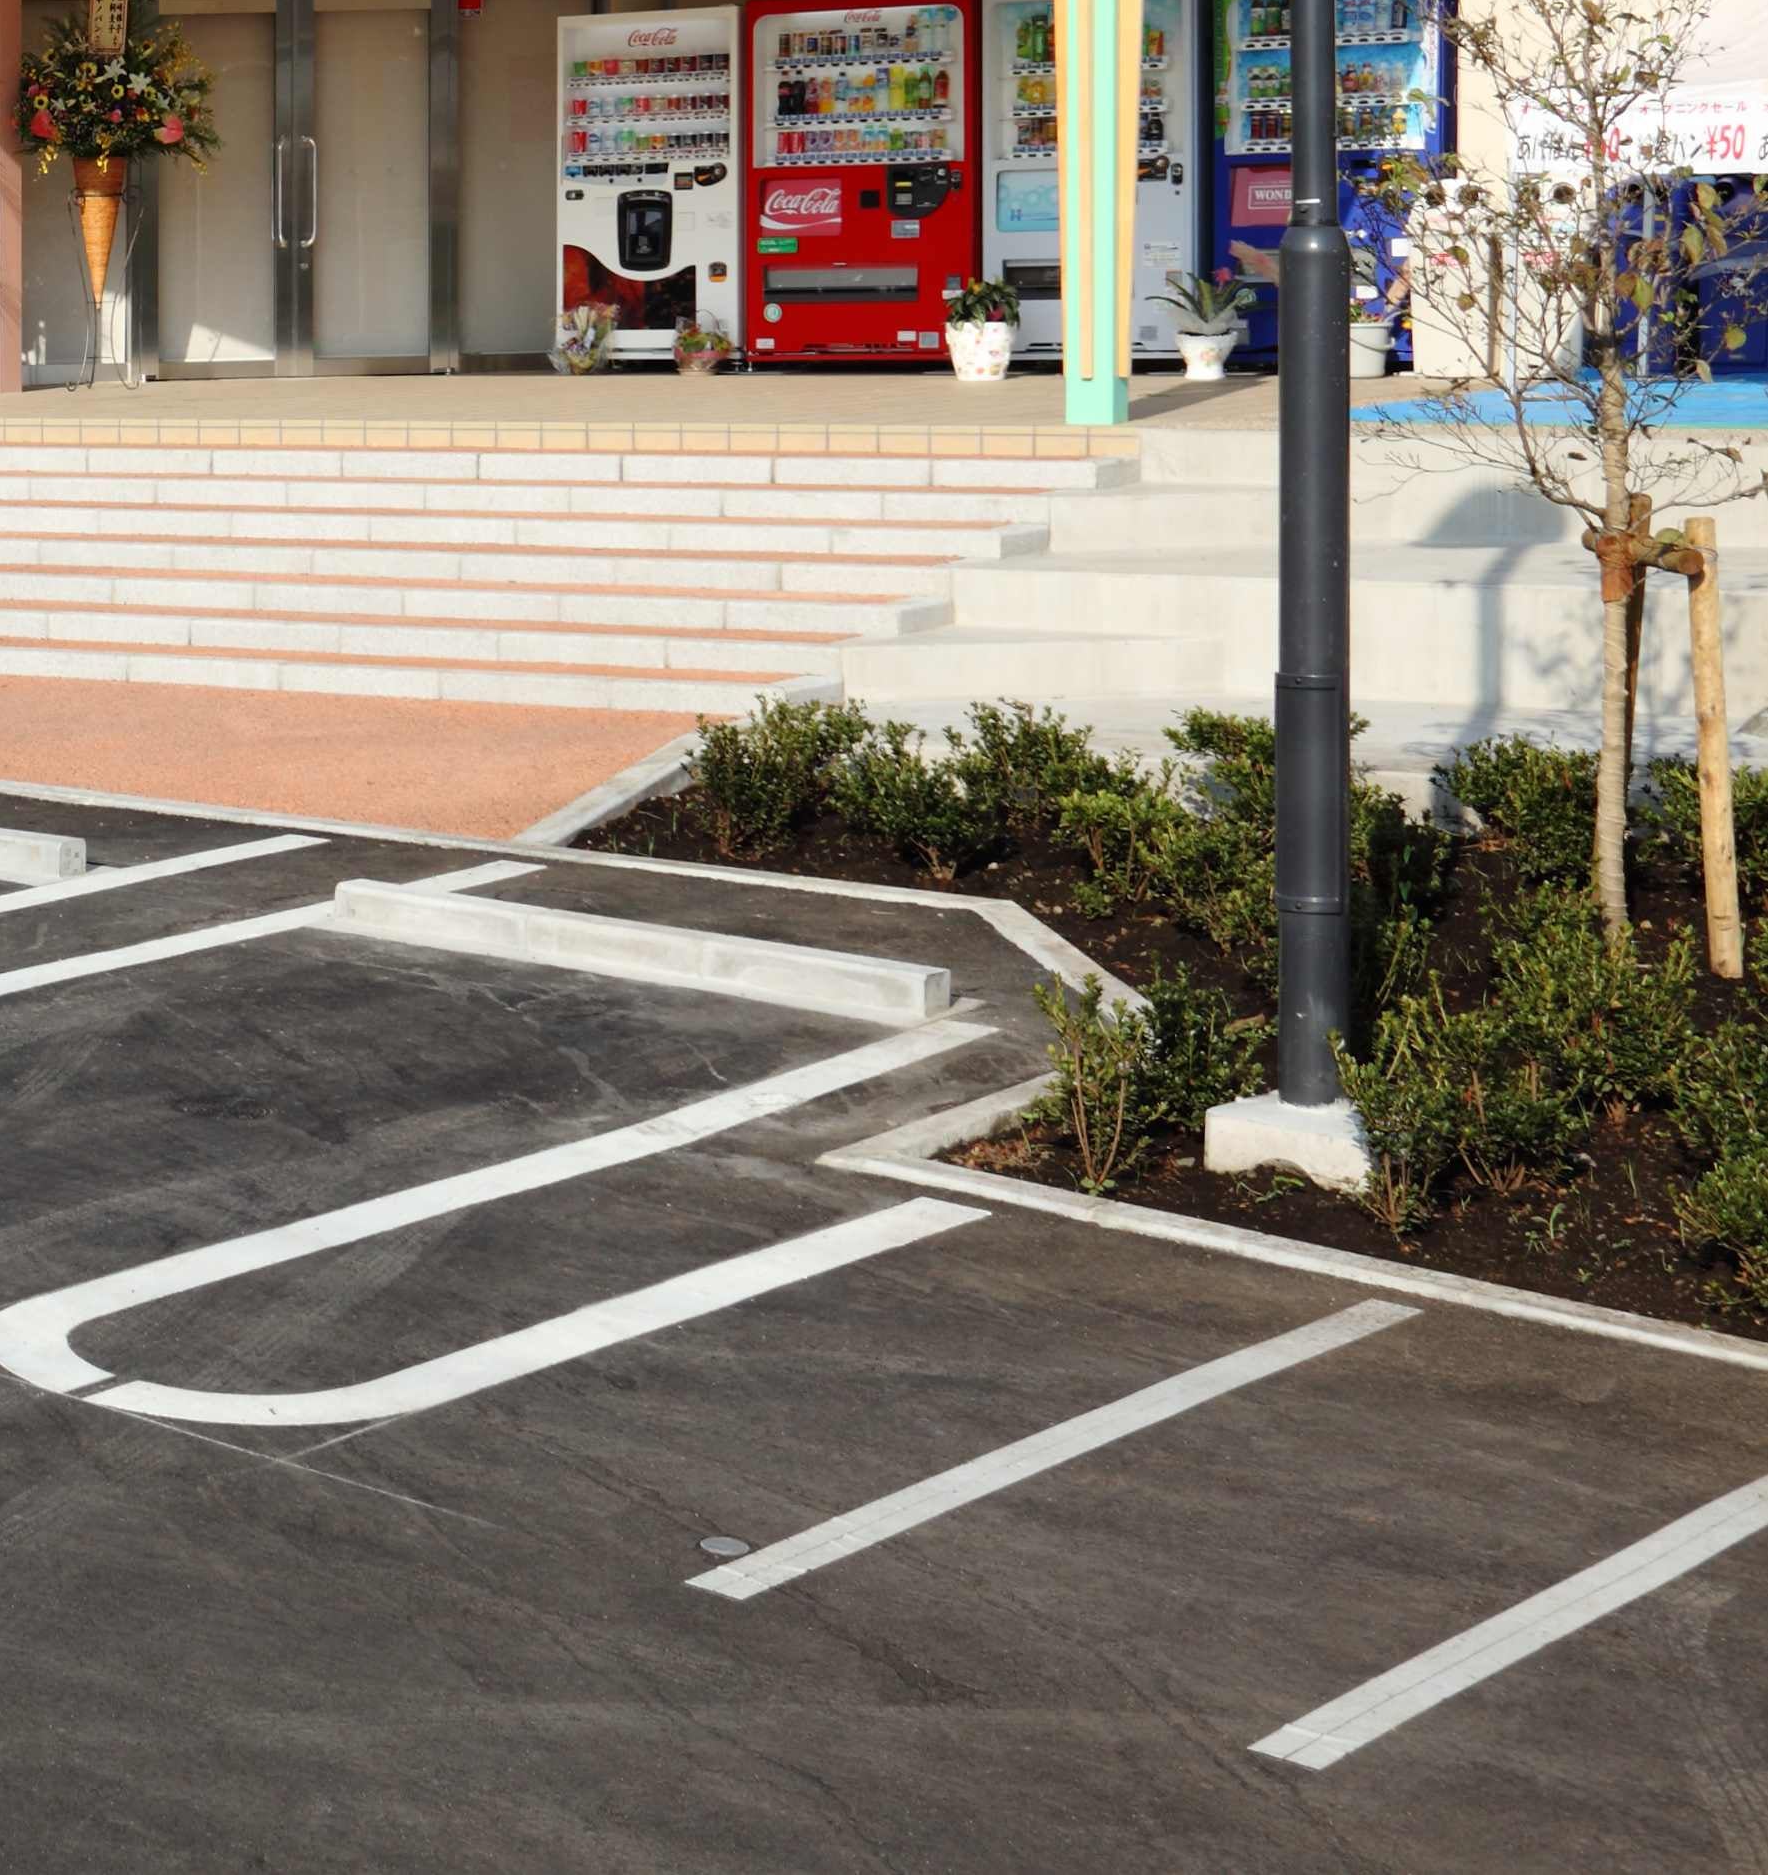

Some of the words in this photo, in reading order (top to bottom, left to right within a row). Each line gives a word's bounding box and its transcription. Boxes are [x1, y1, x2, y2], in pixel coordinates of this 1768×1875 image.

[1707, 125, 1746, 161] ¥50
[765, 188, 841, 215] Coca-Cola
[1255, 189, 1293, 200] WOND
